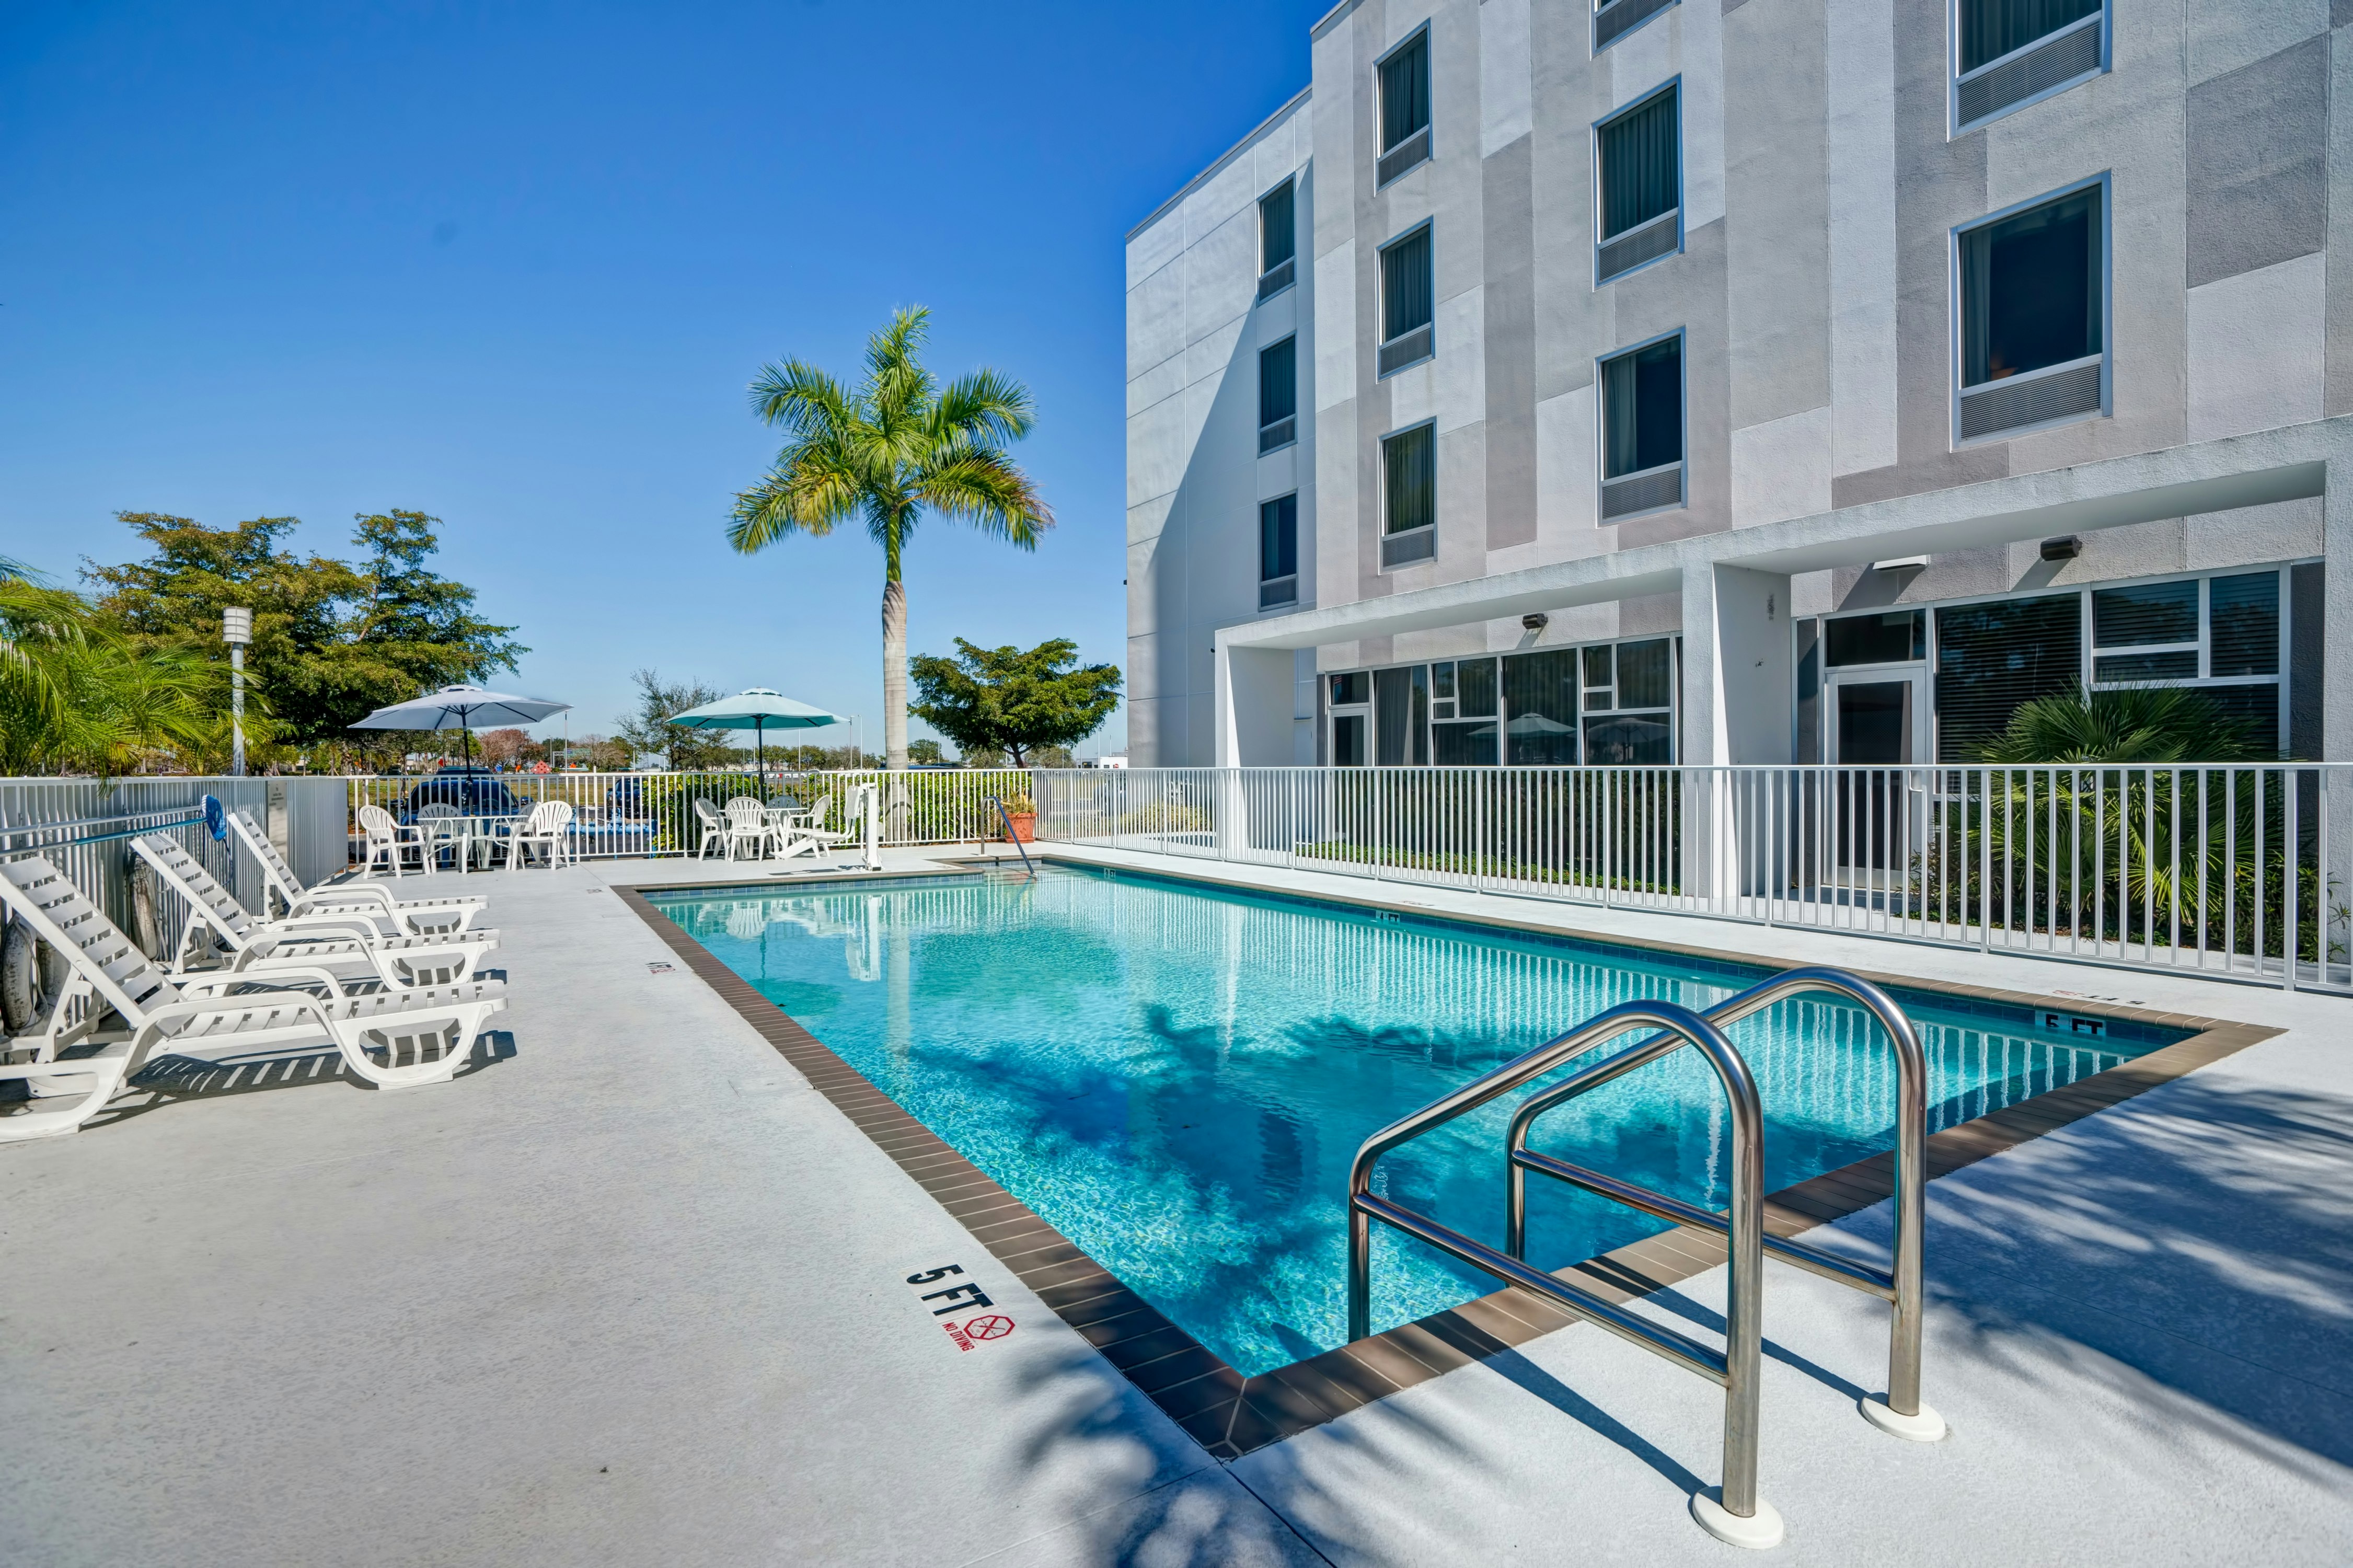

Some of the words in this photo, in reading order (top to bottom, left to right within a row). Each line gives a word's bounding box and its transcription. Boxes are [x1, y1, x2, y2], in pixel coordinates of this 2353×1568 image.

[2046, 1013, 2059, 1028] 5
[2072, 1018, 2103, 1035] FT
[906, 1264, 965, 1285] 5
[920, 1283, 995, 1317] FT
[942, 1322, 958, 1332] NO
[949, 1330, 975, 1352] DIVING
